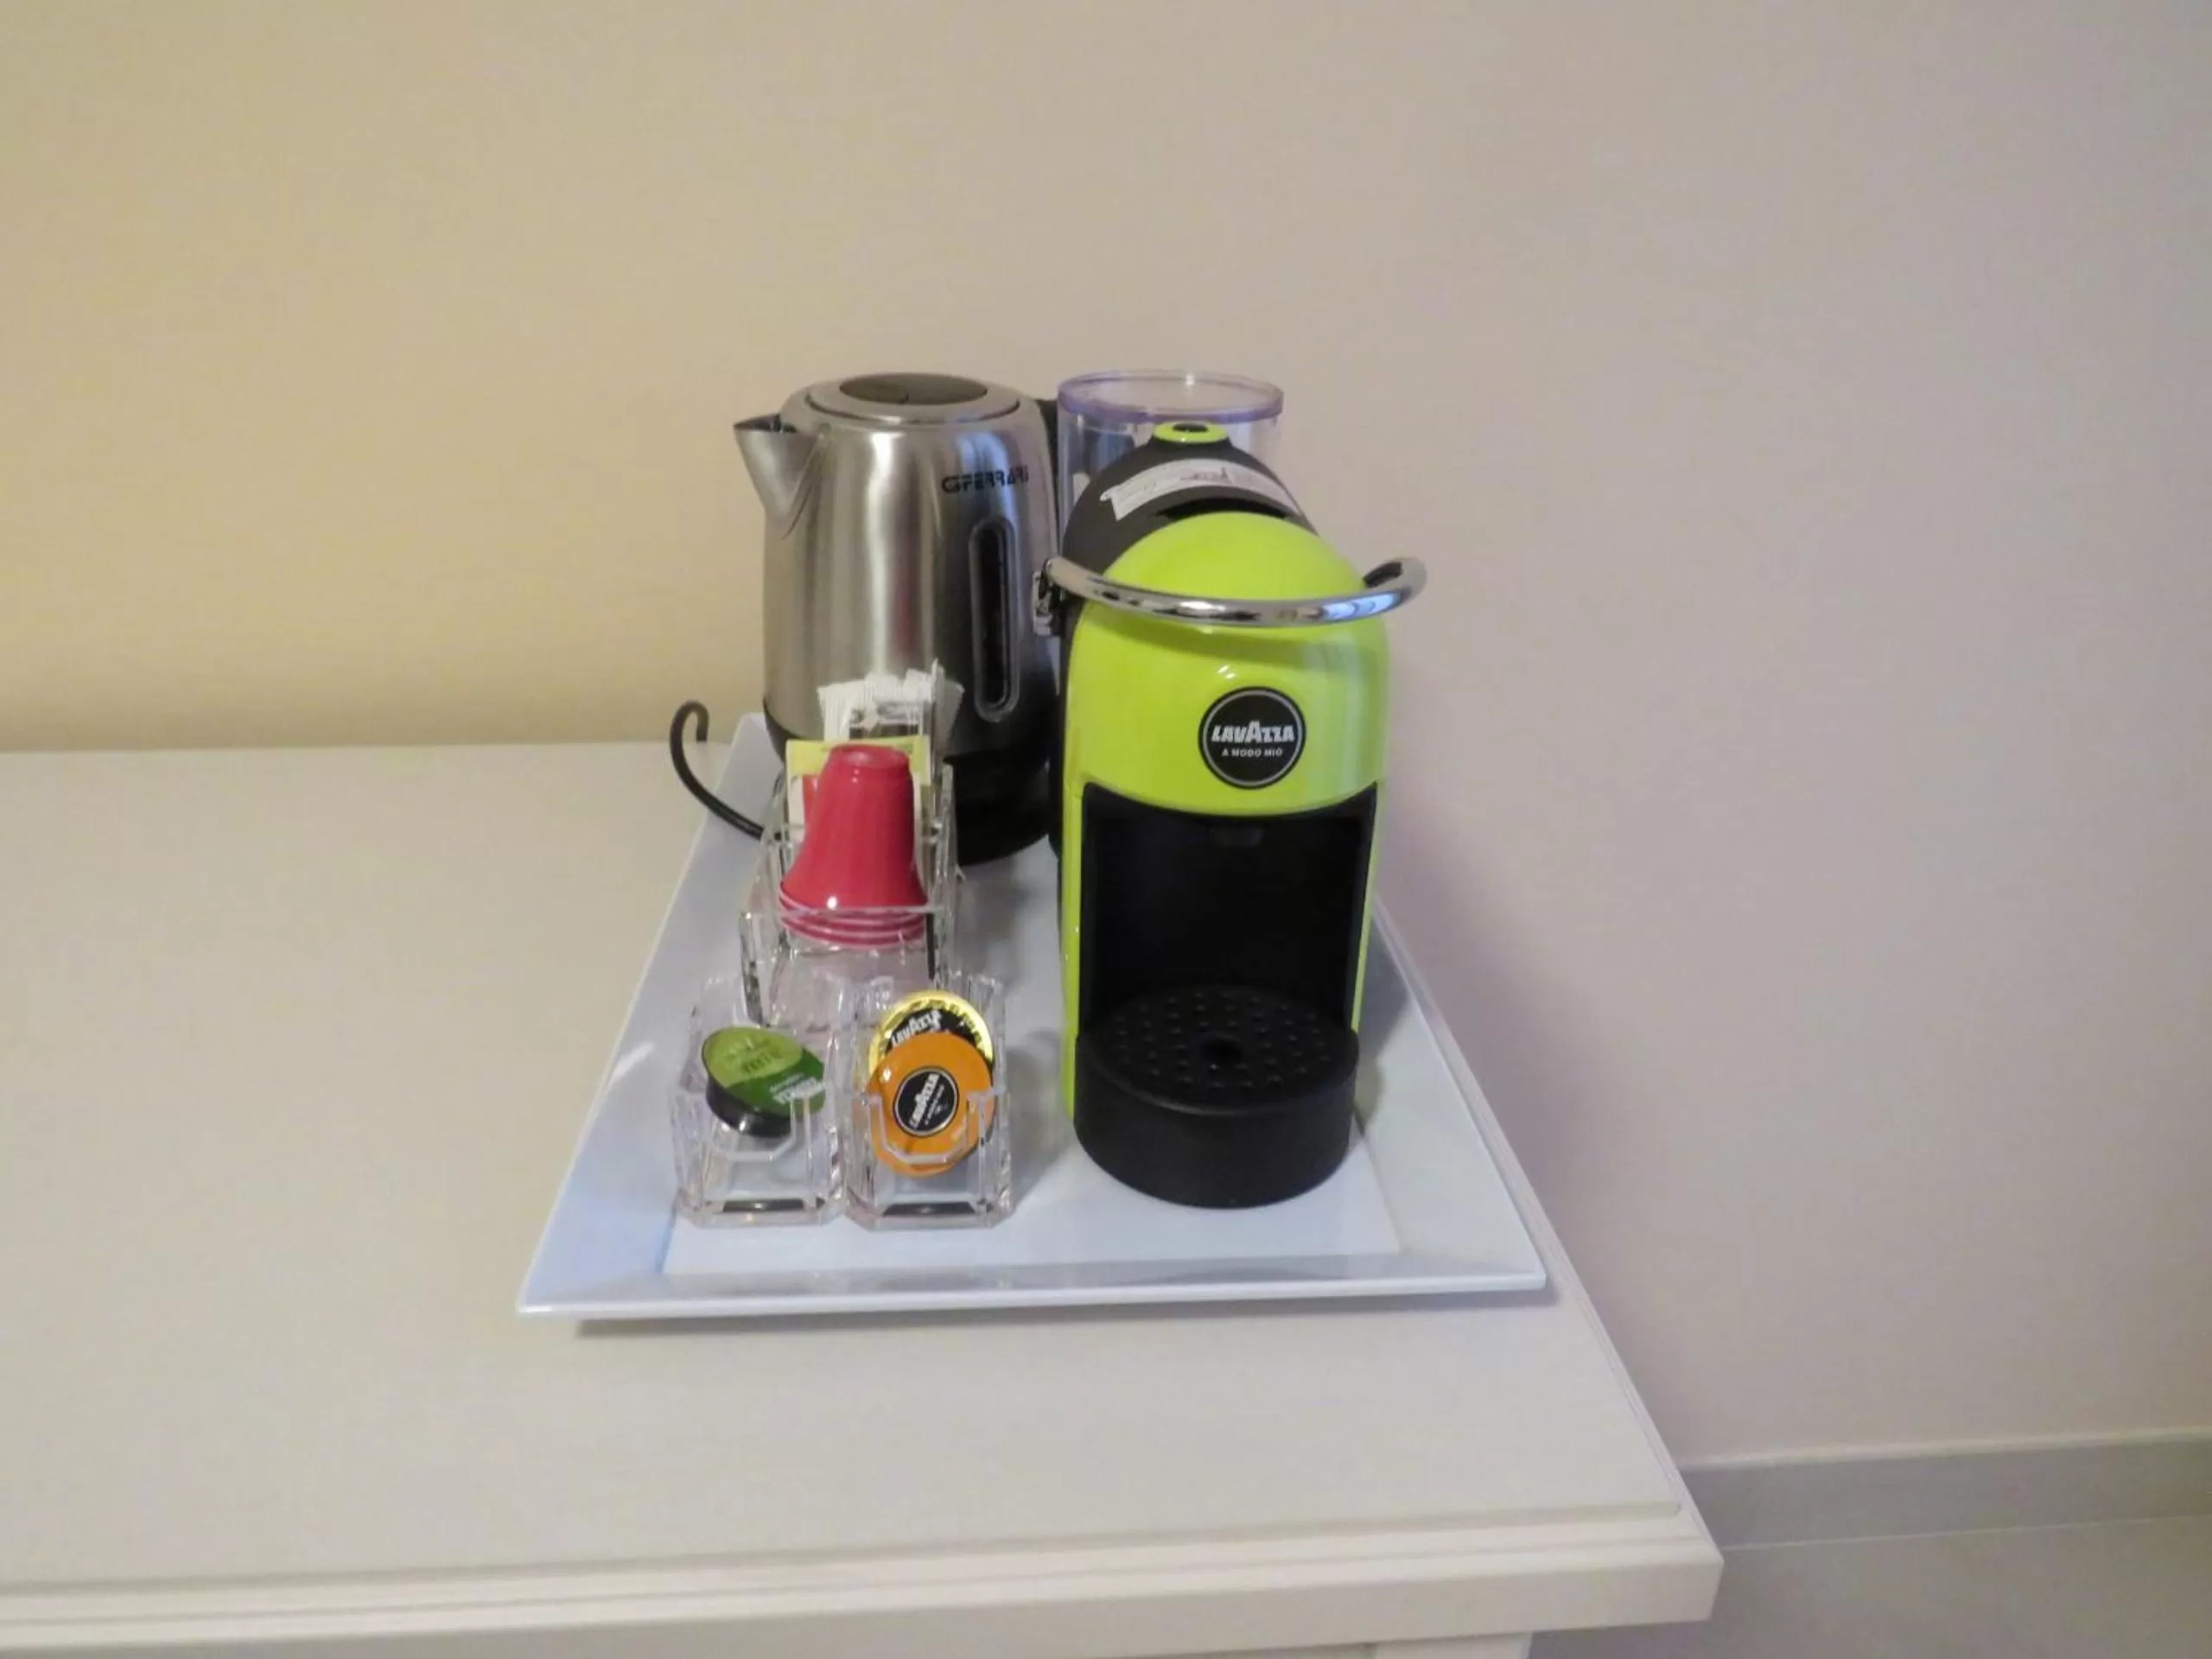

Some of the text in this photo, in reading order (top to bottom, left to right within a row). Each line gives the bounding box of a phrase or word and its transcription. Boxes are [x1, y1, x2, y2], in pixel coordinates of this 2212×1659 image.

[1211, 720, 1295, 743] LAVAZZA
[1222, 748, 1283, 758] A MODO MIO
